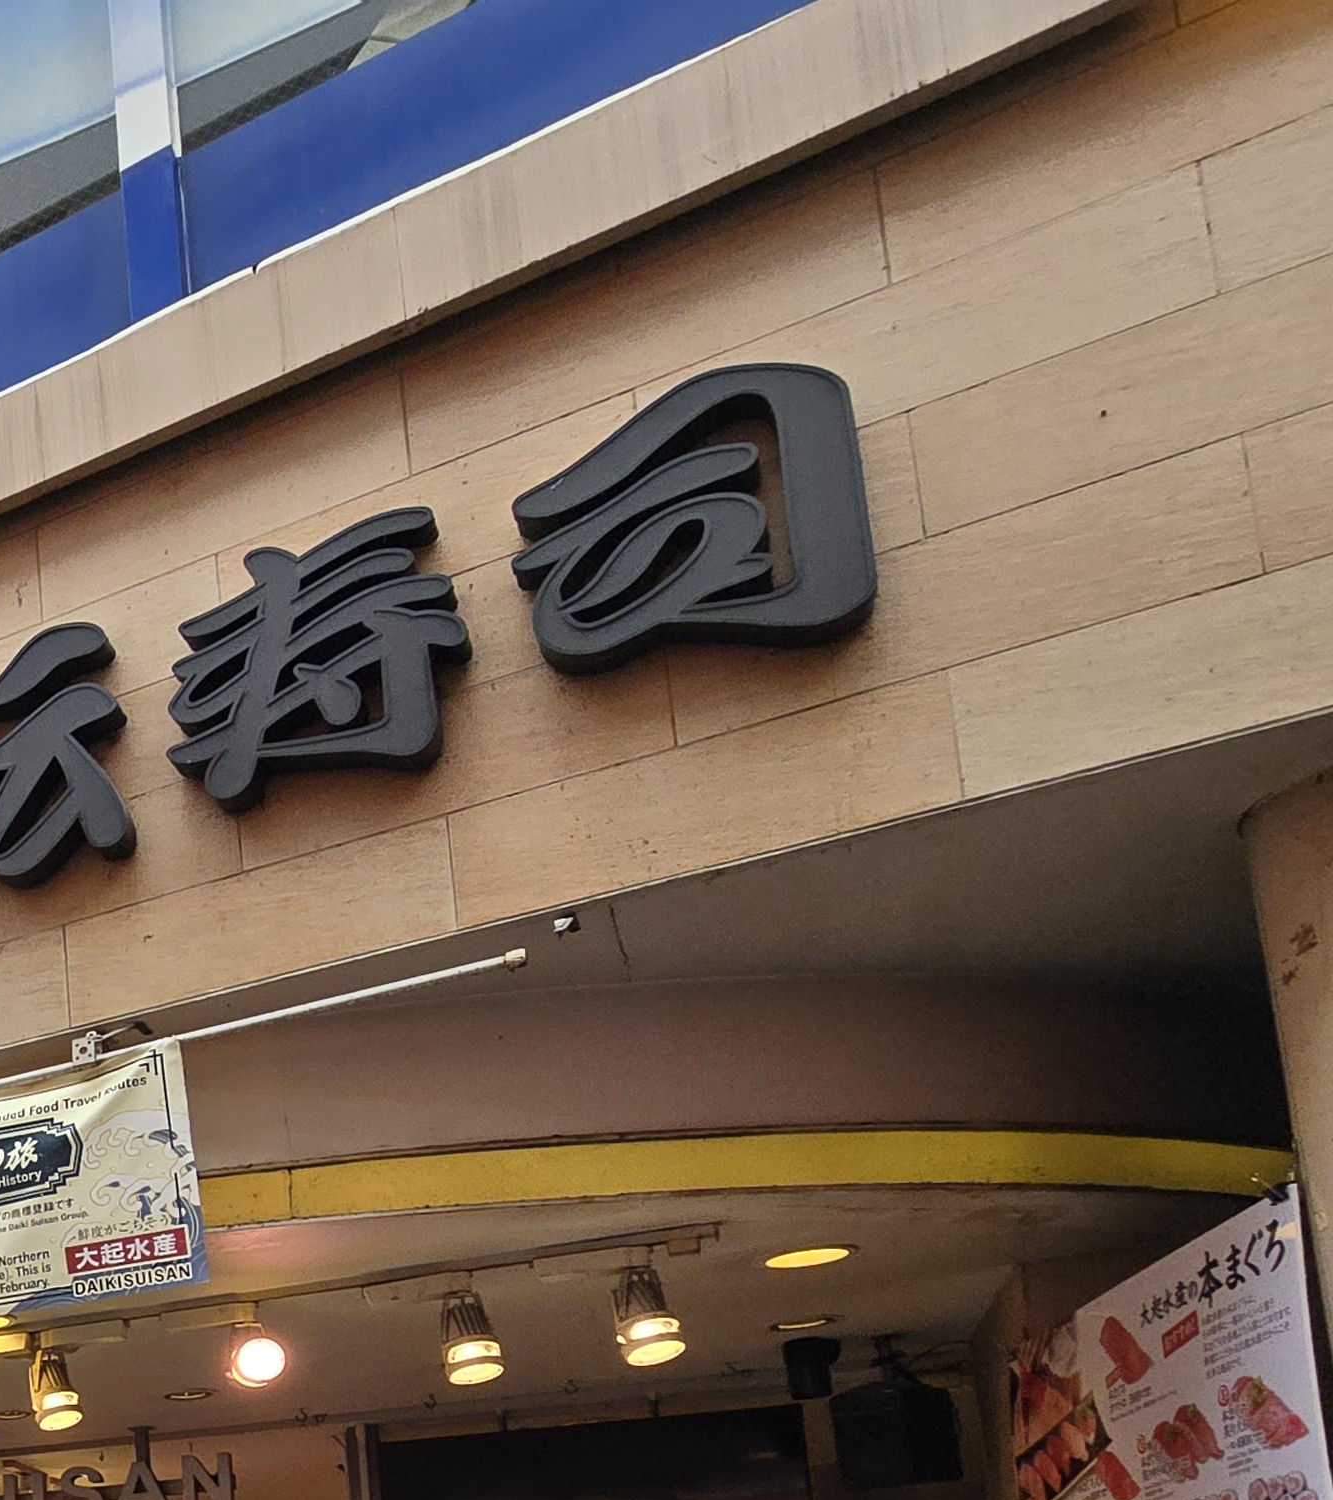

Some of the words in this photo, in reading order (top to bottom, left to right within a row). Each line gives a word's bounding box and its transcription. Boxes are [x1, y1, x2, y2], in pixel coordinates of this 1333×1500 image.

[30, 1101, 59, 1117] Food
[63, 1092, 101, 1111] Travel
[76, 1234, 179, 1270] 大起水産
[15, 1264, 39, 1278] This
[42, 1262, 51, 1273] is
[73, 1264, 193, 1297] DAIKISUISAN
[0, 1277, 51, 1297] February.
